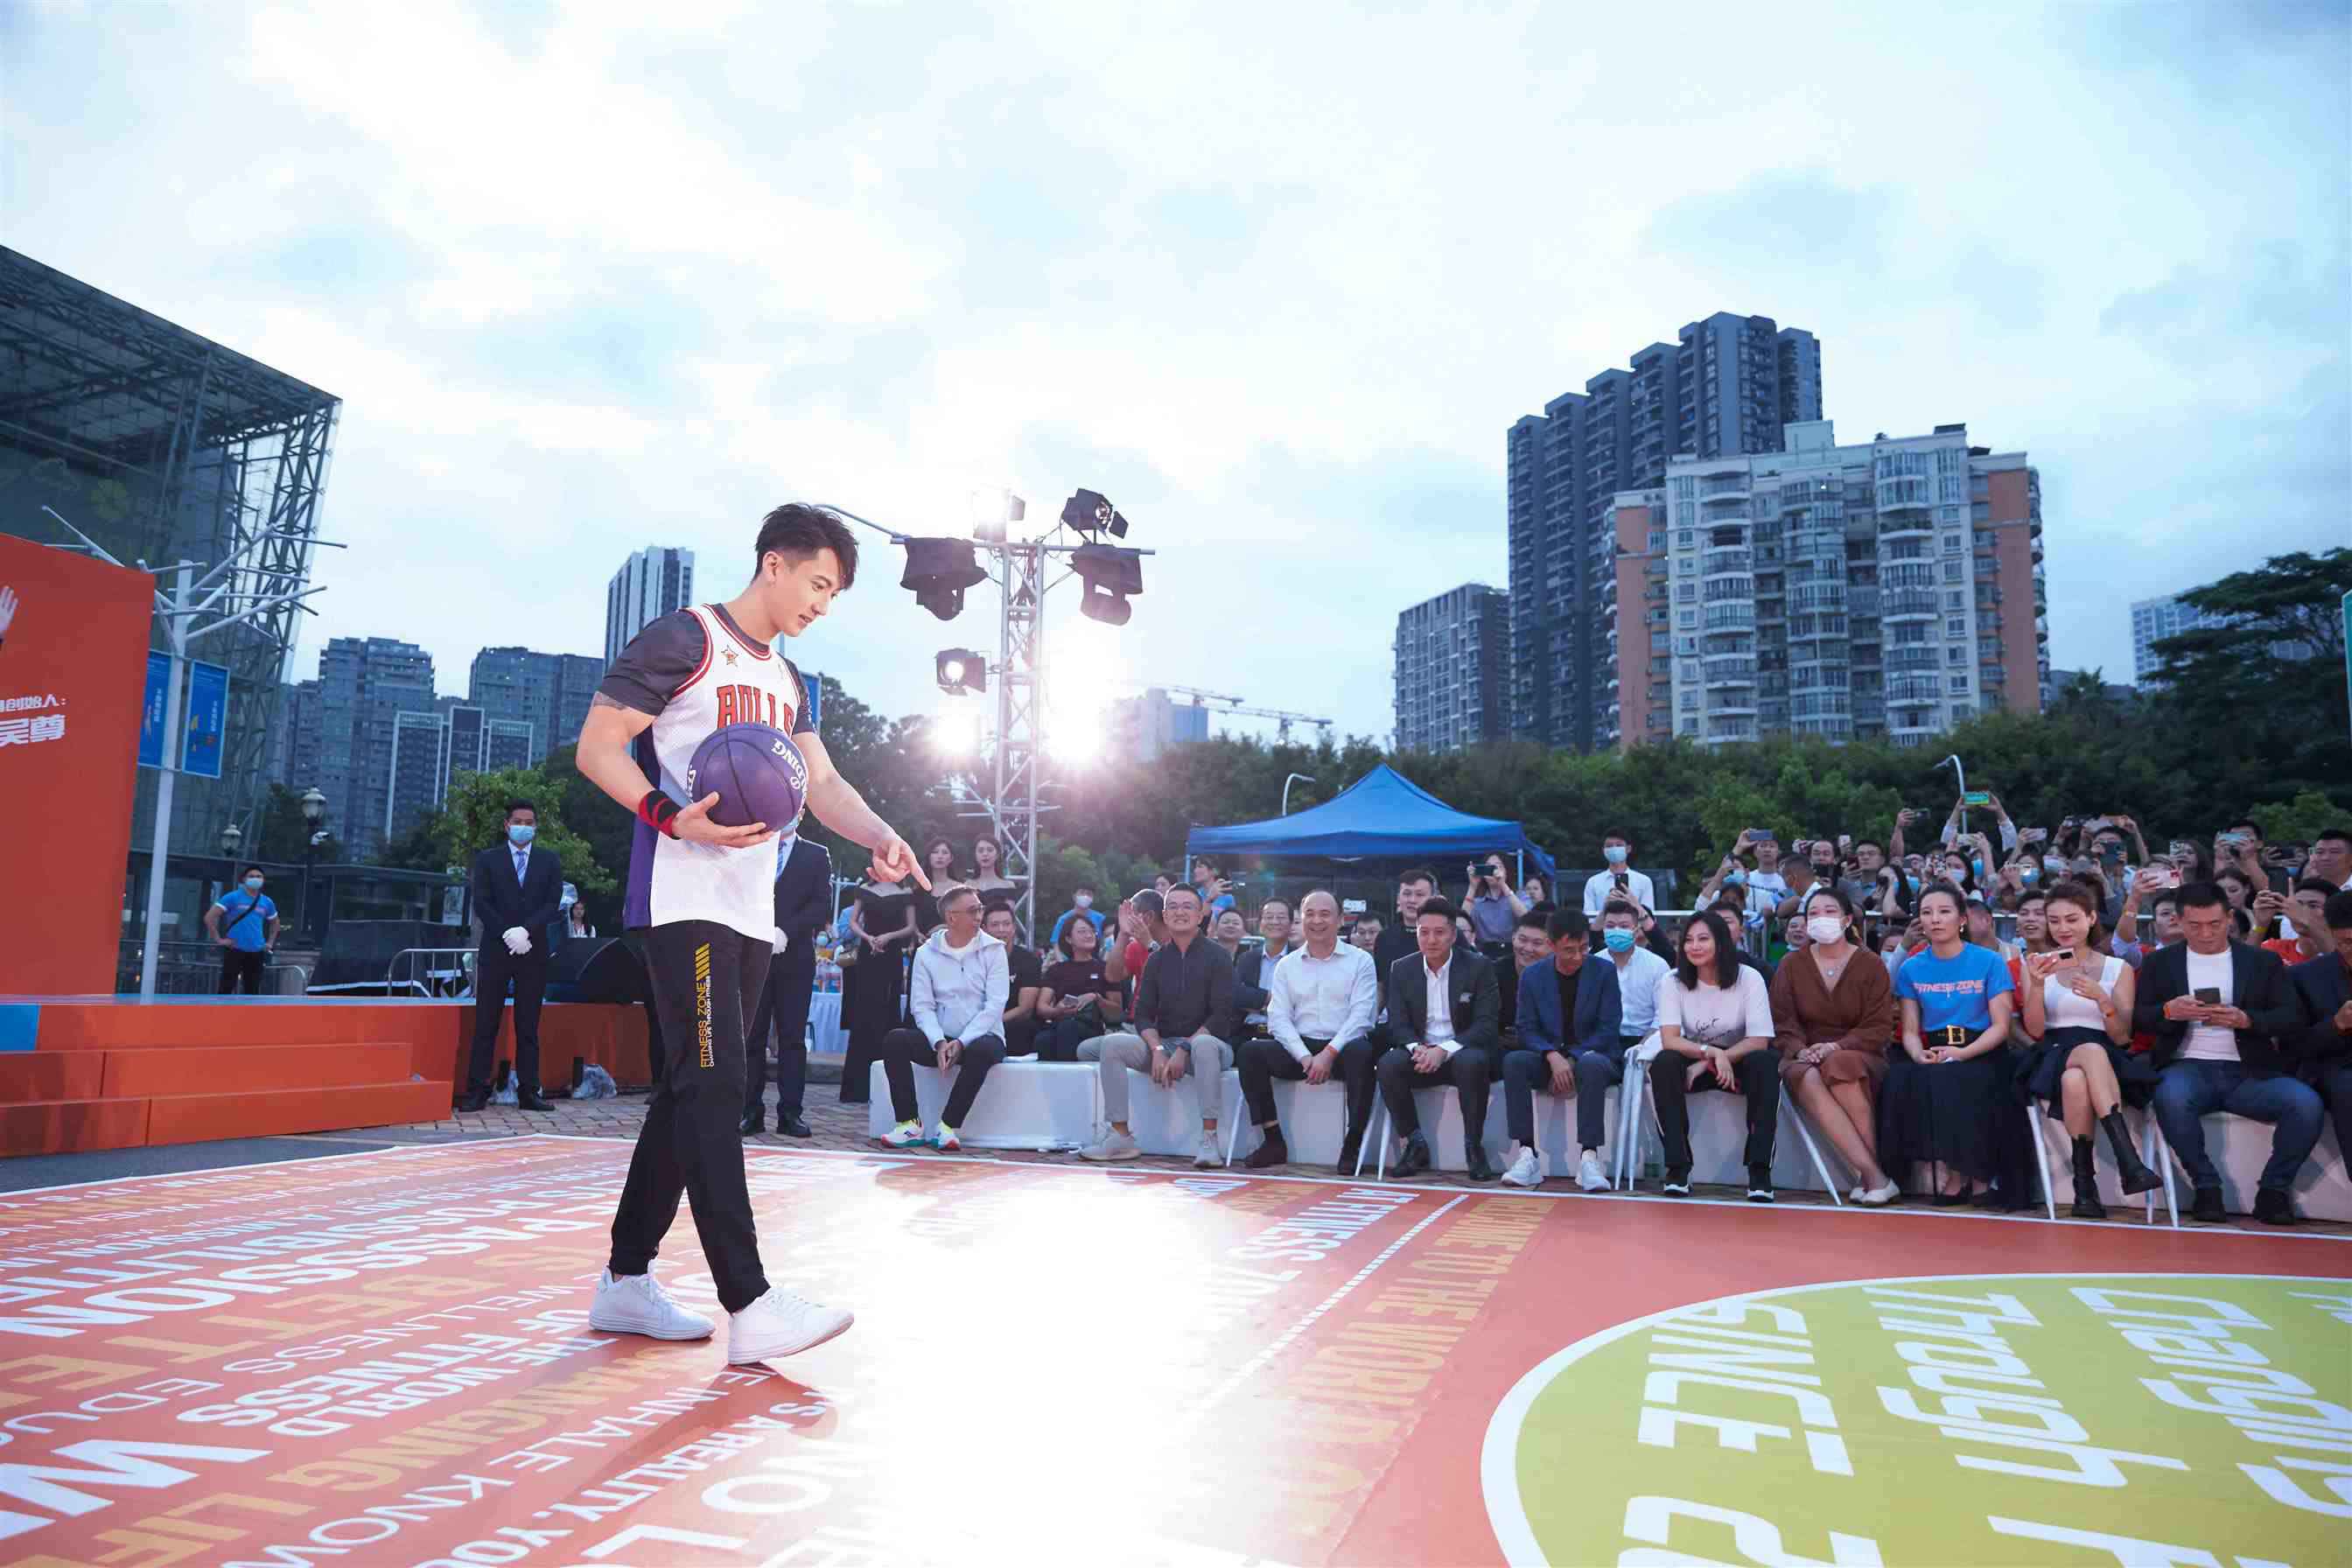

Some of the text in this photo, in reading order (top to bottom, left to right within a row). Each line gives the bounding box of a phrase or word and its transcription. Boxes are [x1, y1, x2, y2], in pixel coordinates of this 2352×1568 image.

[696, 982, 709, 1067] FITNESS ZONE
[44, 1222, 300, 1258] MISSION
[46, 1203, 220, 1224] WHEN
[1225, 1200, 1399, 1263] FITNESS
[1336, 1187, 1420, 1205] AT
[0, 1216, 606, 1338] PASSION
[1363, 1278, 1500, 1322] THE
[1409, 1251, 1516, 1276] TO
[0, 1273, 505, 1406] BETTE
[222, 1282, 579, 1375] WELLNESS
[176, 1332, 527, 1426] FITNESS
[267, 1337, 619, 1437] THE WORLD
[732, 1414, 794, 1432] A
[1637, 1302, 1855, 1477] SINCE
[1862, 1286, 2192, 1488] Through
[486, 1386, 729, 1474] INHALE
[533, 1429, 765, 1521] REALITY.
